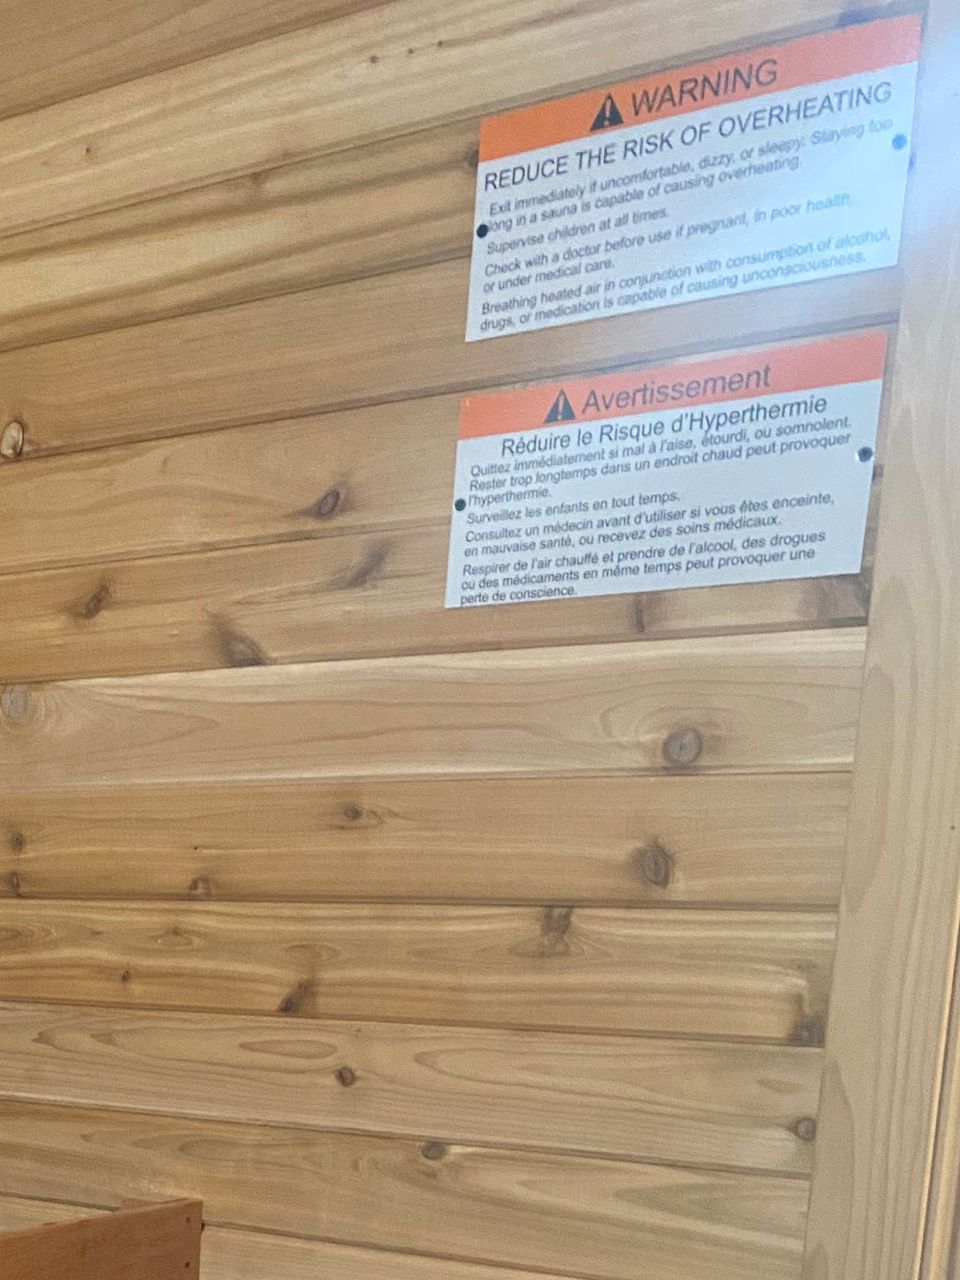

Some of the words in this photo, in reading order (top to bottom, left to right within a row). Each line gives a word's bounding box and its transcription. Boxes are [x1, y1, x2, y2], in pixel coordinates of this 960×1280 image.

[631, 58, 778, 117] WARNING
[484, 154, 568, 192] REDUCE
[574, 142, 616, 170] THE
[622, 128, 674, 160] RISK
[679, 120, 711, 146] OF
[718, 80, 891, 138] OVERHEATING
[488, 199, 511, 217] Exit
[513, 183, 586, 211] immediately
[587, 179, 598, 194] if
[598, 160, 694, 191] uncomfortable,
[739, 146, 754, 161] or
[809, 123, 865, 146] Staying
[515, 214, 527, 227] in
[528, 212, 538, 225] a
[540, 203, 577, 221] sauna
[580, 198, 591, 213] is
[593, 188, 644, 209] capable
[647, 182, 661, 198] of
[663, 173, 715, 194] causing
[484, 257, 521, 277] Check
[524, 252, 548, 268] with
[550, 252, 560, 264] a
[562, 243, 602, 262] doctor
[603, 234, 645, 255] before
[647, 229, 672, 244] use
[675, 223, 684, 239] if
[685, 211, 750, 239] pregnant,
[752, 208, 767, 223] in
[769, 203, 802, 223] poor
[486, 233, 544, 255] Supervise
[546, 222, 595, 243] children
[598, 216, 611, 232] at
[613, 212, 629, 228] all
[481, 294, 537, 315] Breathing
[540, 284, 582, 304] heated
[583, 281, 601, 296] air
[603, 279, 616, 295] in
[618, 265, 691, 290] conjunction
[694, 258, 722, 275] with
[725, 241, 814, 269] consumption
[815, 236, 834, 253] of
[482, 281, 495, 294] or
[497, 273, 532, 291] under
[534, 261, 582, 283] medical
[584, 258, 614, 273] care.
[518, 311, 532, 325] or
[534, 299, 600, 321] medication
[603, 295, 614, 309] is
[616, 286, 667, 306] capable
[669, 280, 684, 298] of
[686, 274, 738, 294] causing
[581, 363, 771, 415] Avertissement
[470, 462, 511, 478] Quittez
[513, 447, 605, 473] immédiatement
[607, 444, 619, 460] si
[621, 441, 645, 458] mal
[647, 440, 656, 455] à
[753, 427, 772, 440] ou
[774, 415, 851, 437] somnolent.
[501, 432, 571, 457] Réduire
[576, 428, 592, 447] le
[598, 420, 665, 444] Risque
[670, 394, 827, 433] d'Hyperthermie
[469, 477, 507, 492] Rester
[509, 474, 533, 487] trop
[534, 466, 597, 484] longtemps
[600, 462, 631, 476] dans
[634, 459, 650, 471] un
[653, 451, 698, 468] endroit
[701, 444, 743, 462] chaud
[745, 440, 776, 458] peut
[779, 433, 851, 454] provoquer
[465, 527, 522, 542] Consultez
[524, 525, 539, 537] un
[542, 518, 593, 534] médecin
[596, 513, 631, 529] avant
[633, 508, 687, 525] d'utiliser
[689, 505, 701, 519] si
[704, 503, 736, 517] vous
[738, 499, 768, 514] êtes
[771, 492, 834, 510] enceinte,
[466, 508, 522, 524] Surveillez
[524, 506, 542, 518] les
[544, 500, 589, 516] enfants
[592, 499, 608, 511] en
[611, 494, 635, 509] tout
[467, 485, 551, 507] l'hyperthermie.
[462, 561, 511, 576] Respirer
[512, 559, 528, 572] de
[530, 556, 552, 570] l'air
[554, 551, 599, 568] chauffé
[601, 550, 614, 564] et
[616, 545, 665, 563] prendre
[668, 544, 685, 557] de
[741, 535, 766, 550] des
[769, 531, 825, 547] drogues
[463, 546, 478, 557] en
[480, 539, 536, 555] mauvaise
[577, 535, 594, 546] ou
[597, 529, 646, 544] recevez
[648, 525, 672, 538] des
[675, 521, 710, 535] soins
[713, 514, 781, 532] médicaux.
[460, 580, 475, 592] ou
[478, 576, 499, 589] des
[501, 569, 579, 587] médicaments
[582, 569, 598, 580] en
[601, 564, 640, 578] même
[643, 561, 682, 574] temps
[685, 555, 714, 572] peut
[717, 550, 786, 569] provoquer
[788, 546, 815, 560] une
[459, 591, 489, 606] perte
[491, 589, 506, 602] de
